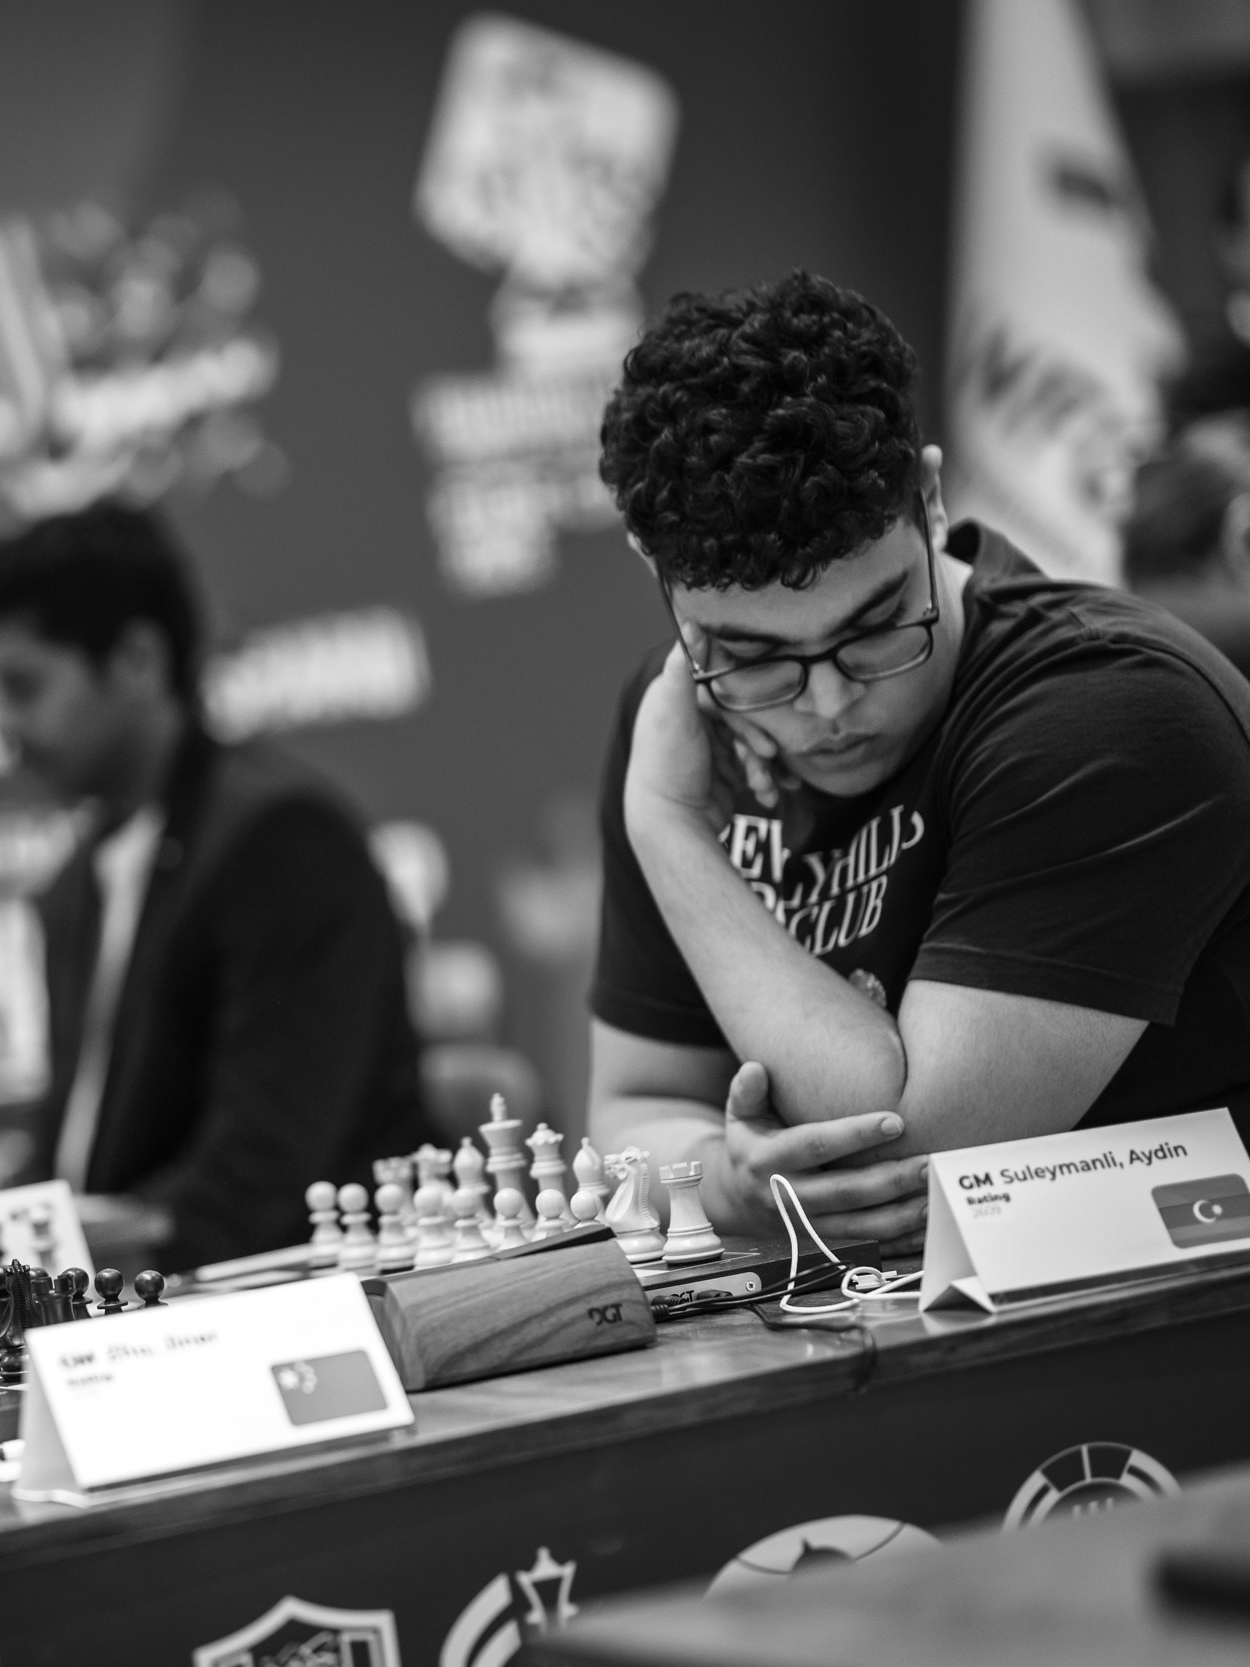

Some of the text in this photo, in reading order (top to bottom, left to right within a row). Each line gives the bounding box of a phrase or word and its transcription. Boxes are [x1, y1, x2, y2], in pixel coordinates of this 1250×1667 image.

[789, 875, 887, 957] CLUB
[958, 1142, 1188, 1190] GM Suleymanli, Aydin
[966, 1193, 1011, 1205] Rating
